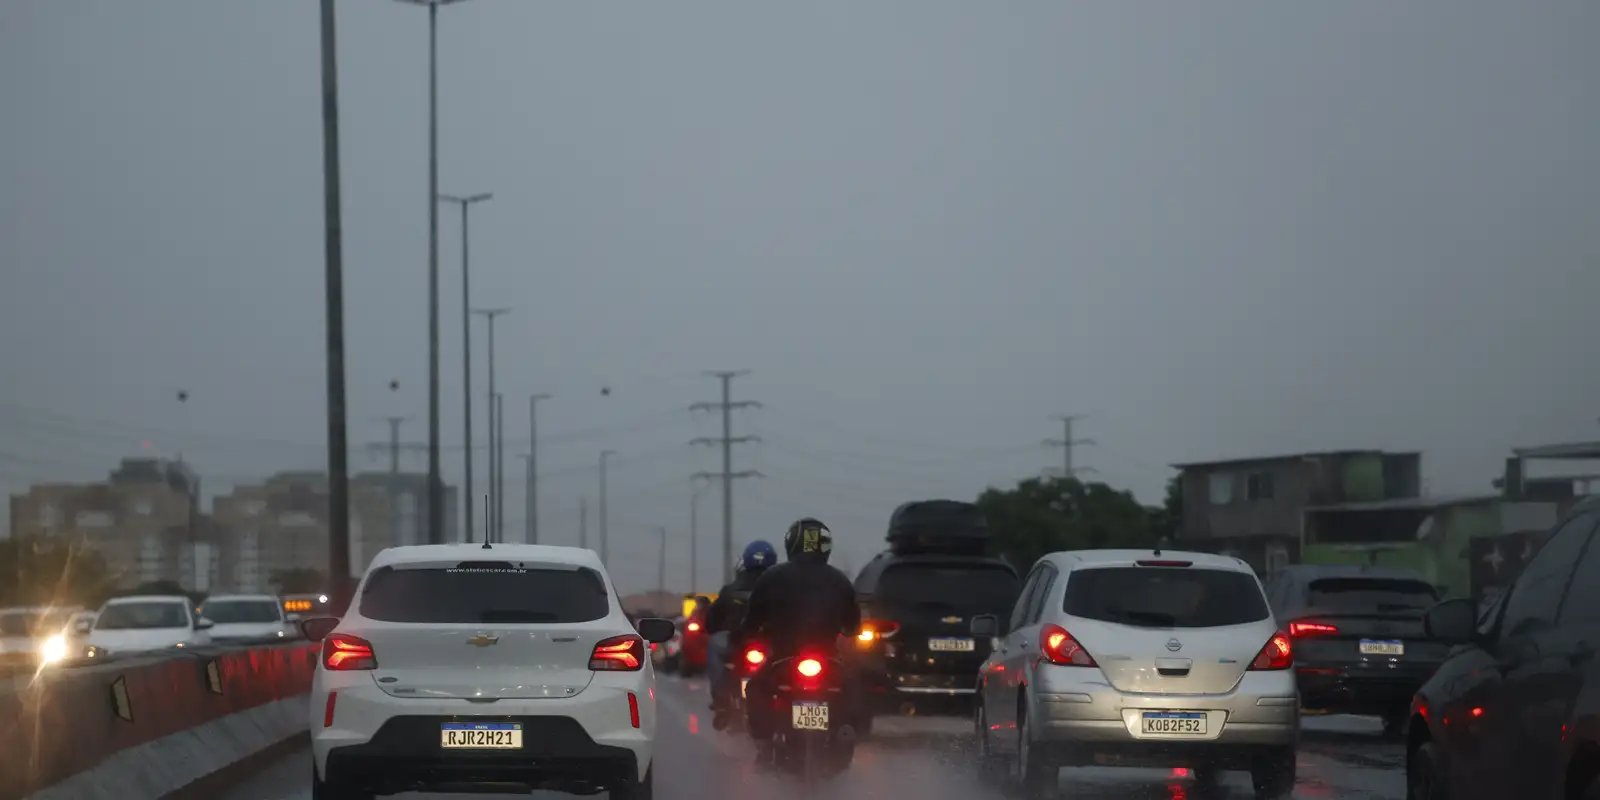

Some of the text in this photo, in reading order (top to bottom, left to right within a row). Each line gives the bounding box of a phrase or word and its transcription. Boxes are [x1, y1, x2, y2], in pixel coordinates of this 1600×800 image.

[797, 716, 824, 727] 4D59
[1148, 720, 1200, 731] KOB2F52
[448, 731, 513, 745] RJR2H21
